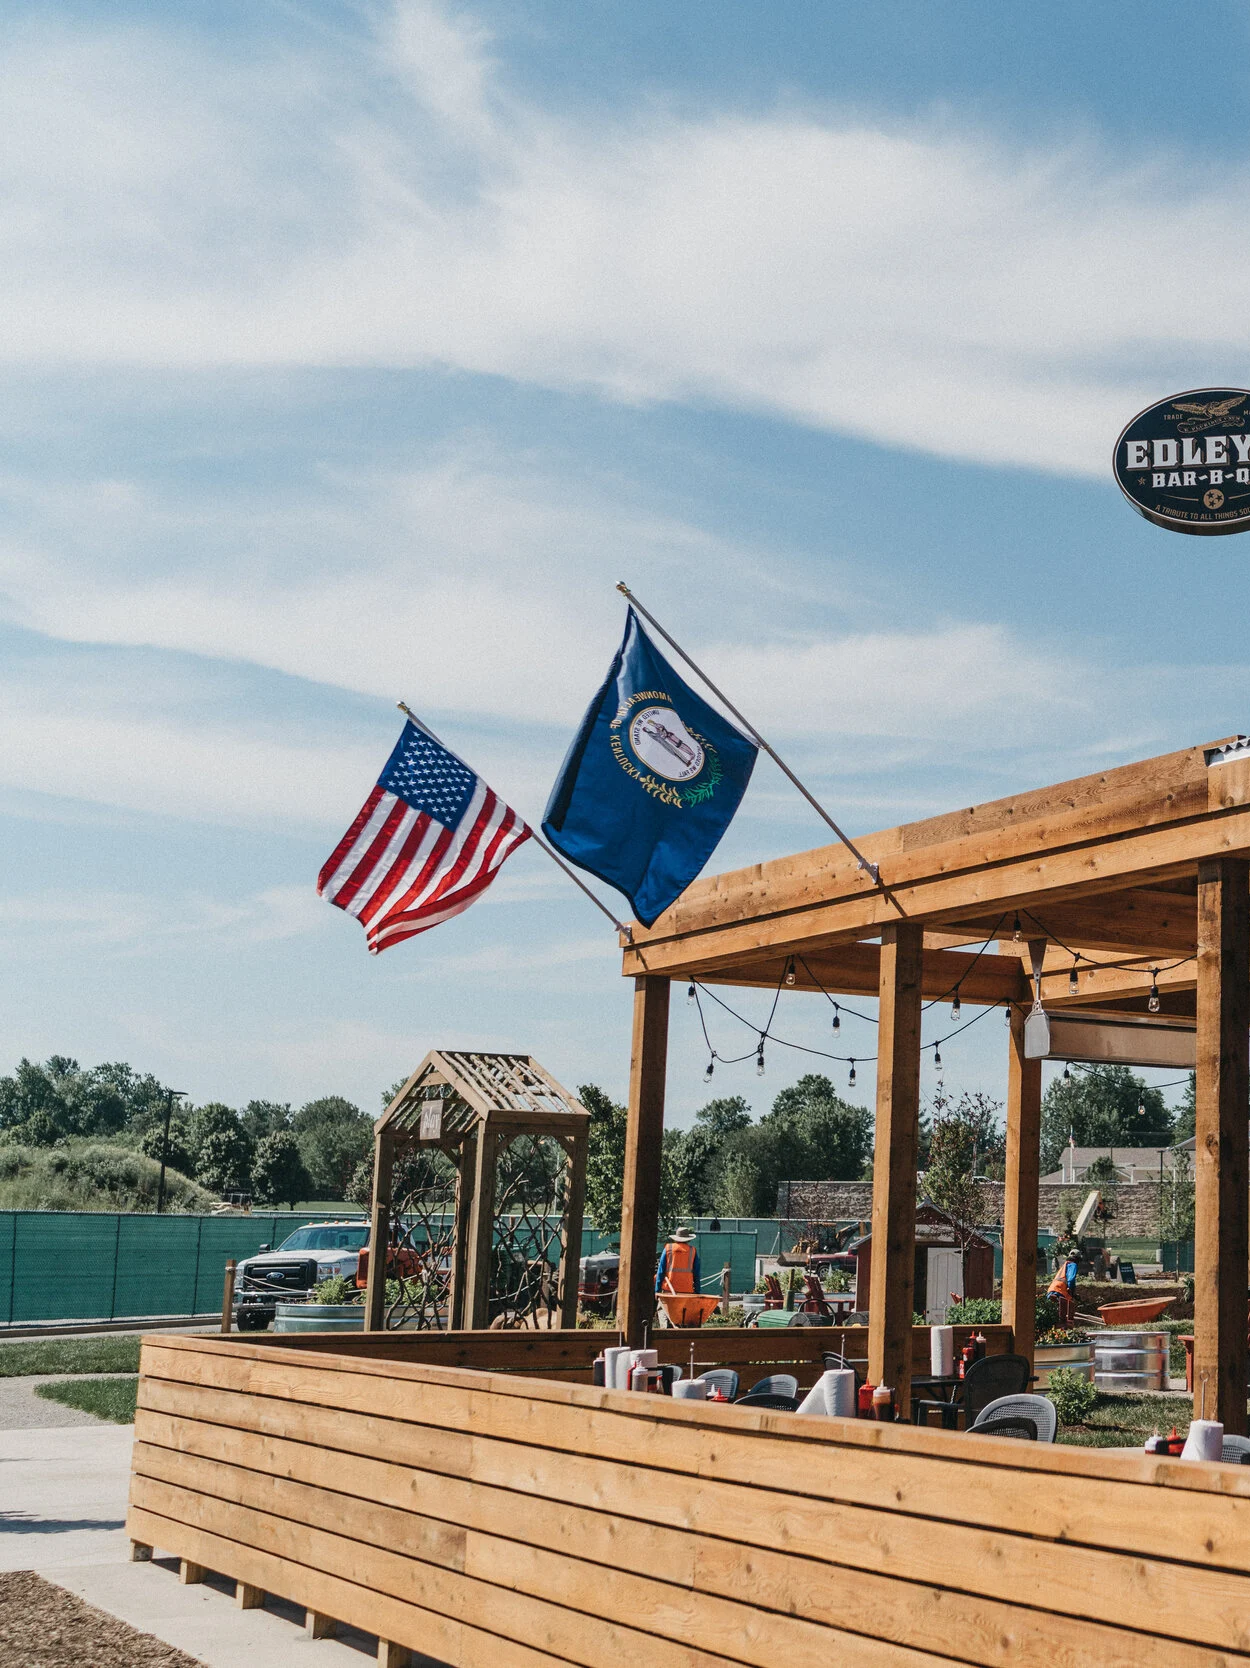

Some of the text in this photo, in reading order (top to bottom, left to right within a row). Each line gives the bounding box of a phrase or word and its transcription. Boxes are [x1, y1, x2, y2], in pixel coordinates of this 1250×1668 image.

[1155, 504, 1160, 512] A
[1162, 506, 1188, 519] TRIBUTE
[1190, 512, 1198, 520] TO
[1215, 511, 1238, 520] THINGS
